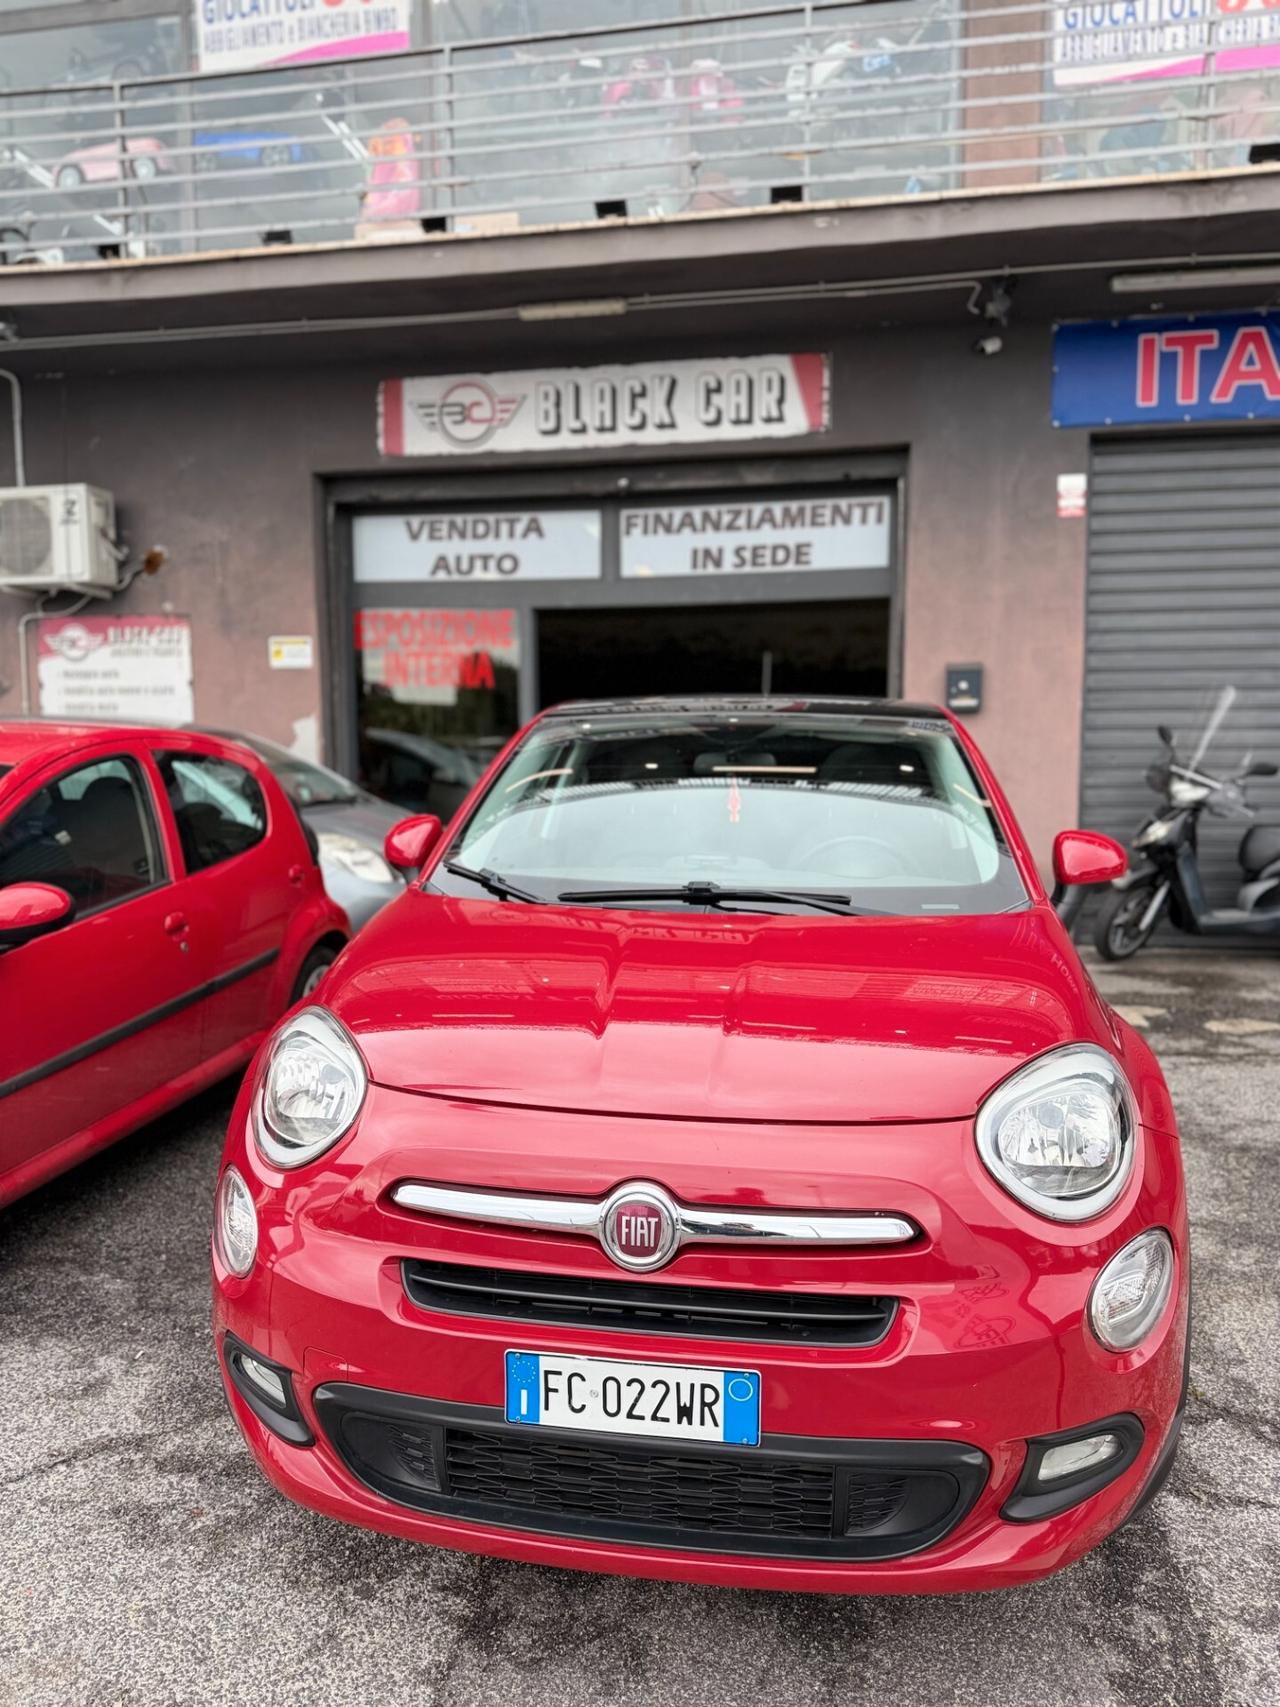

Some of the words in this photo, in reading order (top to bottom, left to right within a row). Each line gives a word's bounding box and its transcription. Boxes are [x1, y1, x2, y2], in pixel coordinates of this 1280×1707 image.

[1136, 326, 1280, 408] ITA
[536, 372, 677, 435] BLACK
[695, 367, 785, 428] CAR
[405, 516, 545, 542] VENDITA
[624, 501, 885, 536] FINANZIAMENTI
[430, 552, 520, 576] AUTO
[691, 547, 724, 571] IN
[733, 543, 813, 569] SEDE
[354, 608, 515, 650] ESPOSIZIONE
[384, 649, 496, 689] INTERNA
[620, 1215, 659, 1248] FIAT
